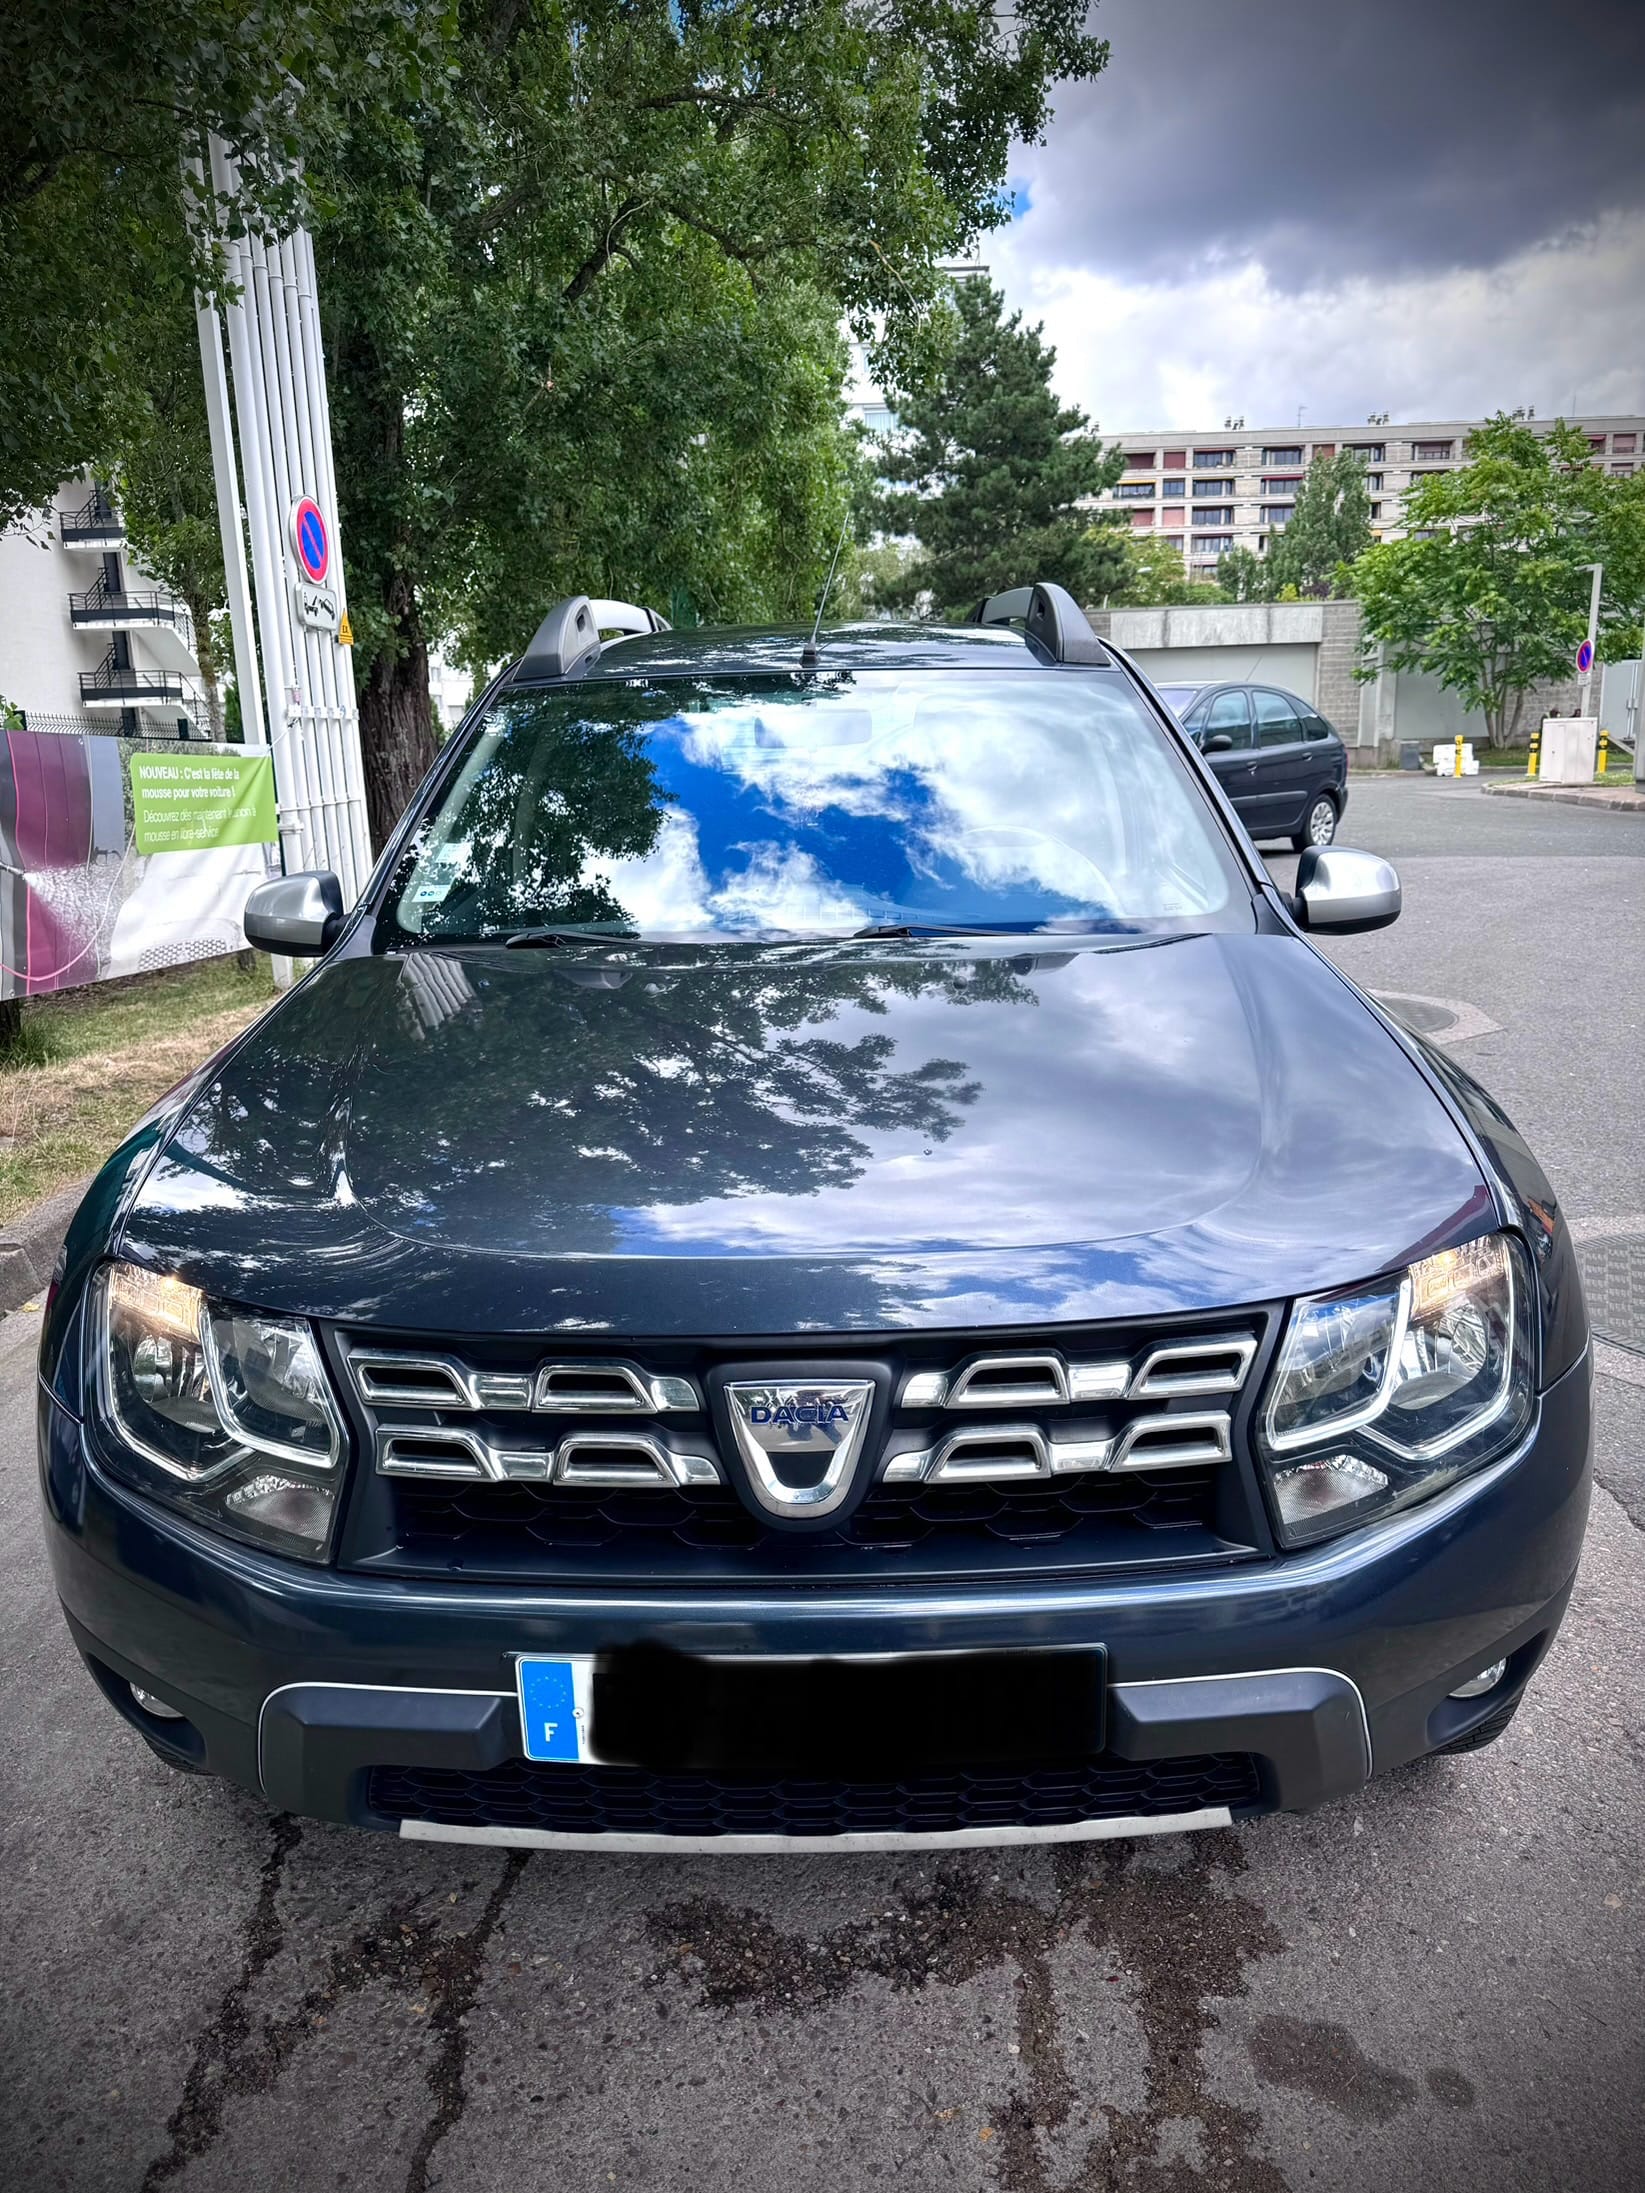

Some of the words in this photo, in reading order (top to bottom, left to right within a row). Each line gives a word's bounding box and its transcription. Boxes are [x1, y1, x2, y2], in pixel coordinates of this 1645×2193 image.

[139, 766, 178, 779] NOUVEAU
[184, 767, 203, 780] C'est
[204, 768, 211, 780] la
[225, 768, 233, 780] de
[234, 768, 240, 780] la
[142, 788, 172, 798] mousse
[173, 788, 189, 801] pour
[191, 786, 208, 798] votre
[210, 786, 231, 798] voiture
[143, 810, 179, 823] Découvrez
[180, 808, 192, 821] dès
[144, 831, 170, 842] mousse
[171, 829, 179, 840] en
[750, 1405, 849, 1424] DACIA
[544, 1722, 558, 1742] F
